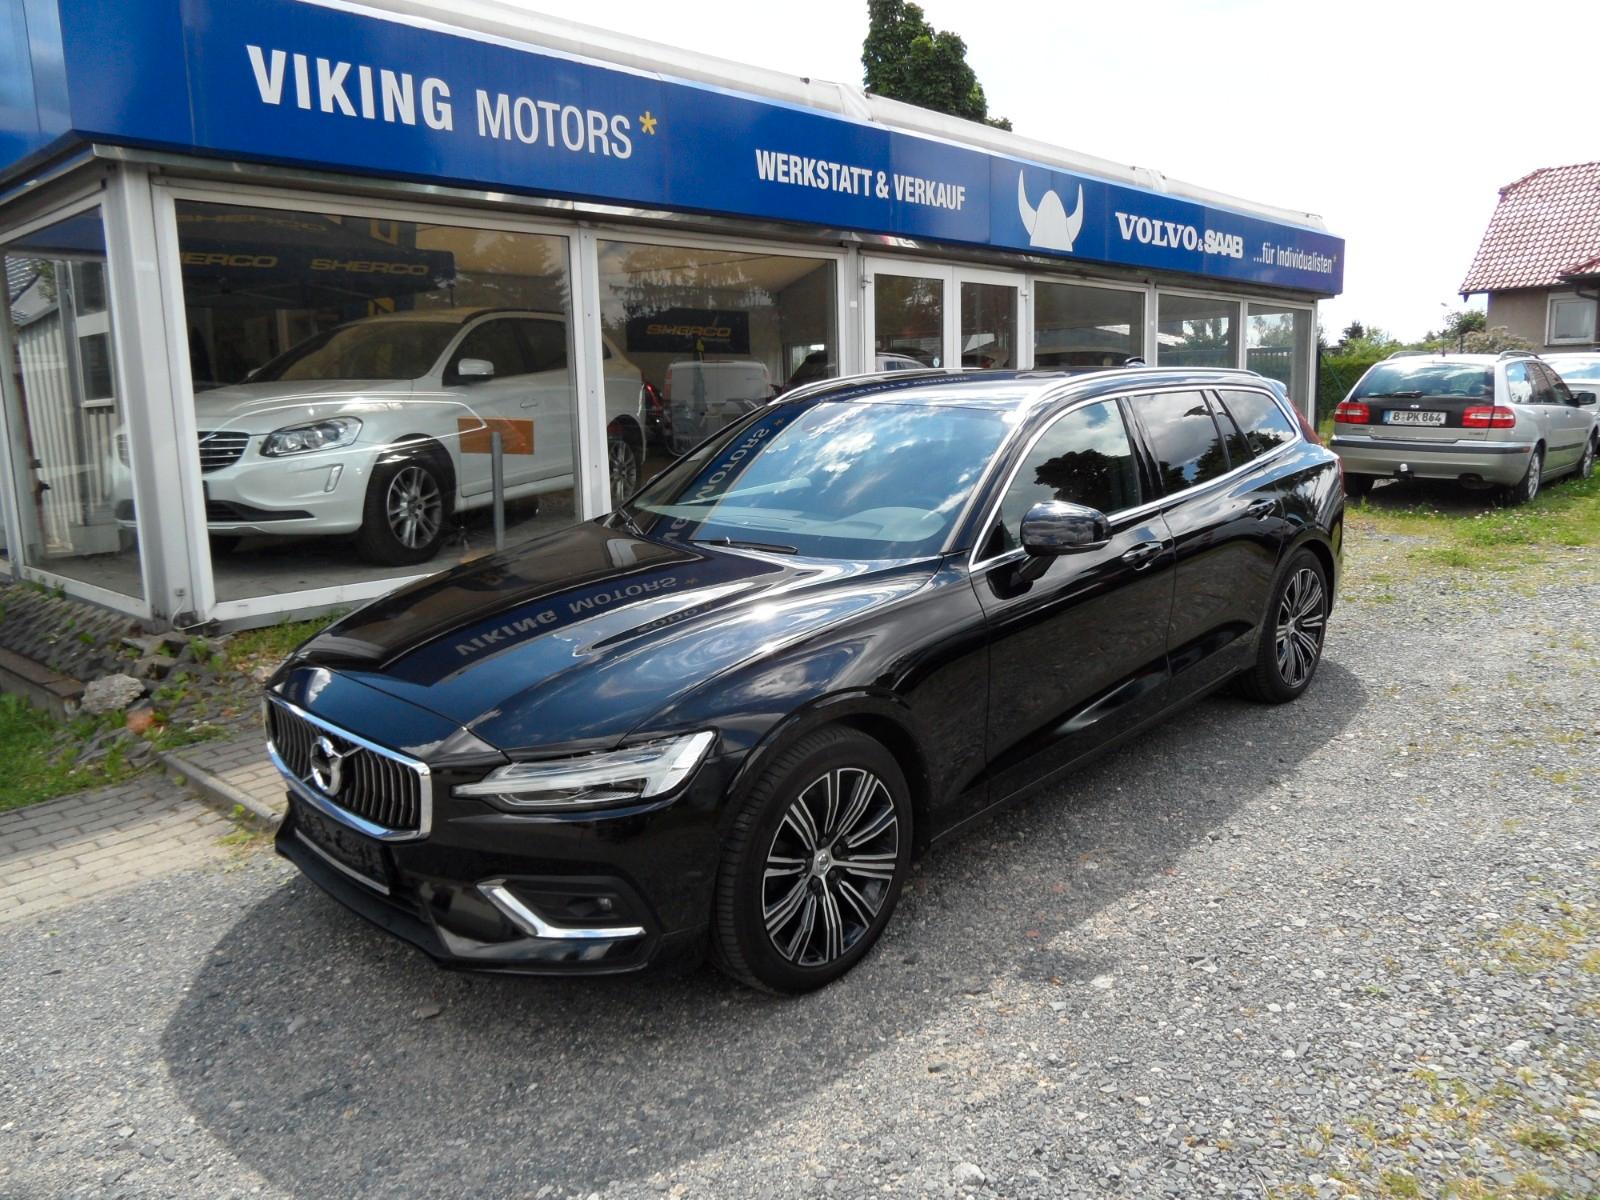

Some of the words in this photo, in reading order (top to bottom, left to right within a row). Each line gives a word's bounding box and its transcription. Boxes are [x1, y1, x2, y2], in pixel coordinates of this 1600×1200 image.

[246, 44, 454, 131] VIKING
[755, 148, 873, 197] WERKSTATT
[875, 170, 889, 199] &
[893, 173, 966, 211] VERKAUF
[1115, 211, 1198, 251] VOLVO
[1204, 229, 1244, 260] SAAB
[309, 258, 430, 276] SHERCO
